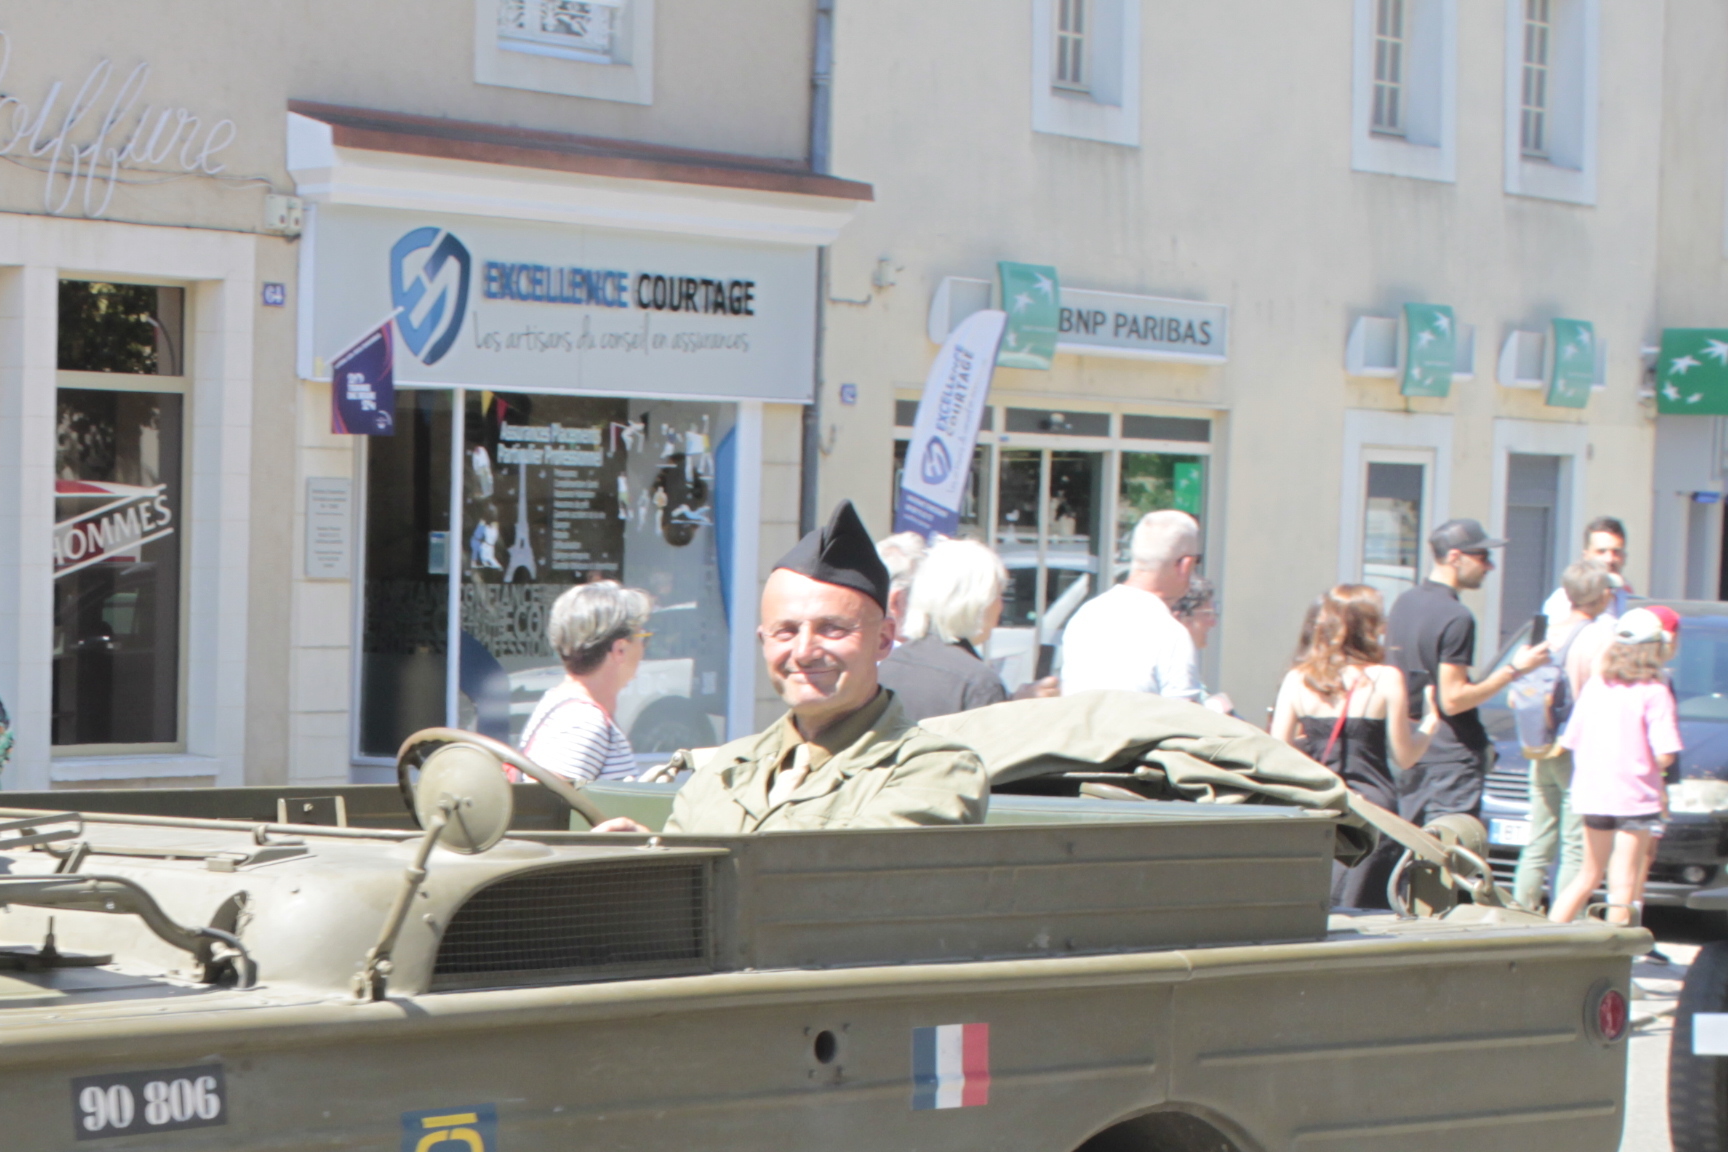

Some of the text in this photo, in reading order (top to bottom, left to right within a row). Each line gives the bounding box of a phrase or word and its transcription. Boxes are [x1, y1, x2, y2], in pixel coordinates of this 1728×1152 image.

[483, 260, 755, 316] EXCELLENCE COURTAGE
[506, 326, 572, 352] artisans
[1059, 308, 1213, 346] BNP PARIBAS
[935, 344, 964, 432] EXCELLENCE
[946, 350, 975, 437] COURTAGE
[53, 495, 171, 566] HOMMES
[79, 1075, 221, 1132] 90 806
